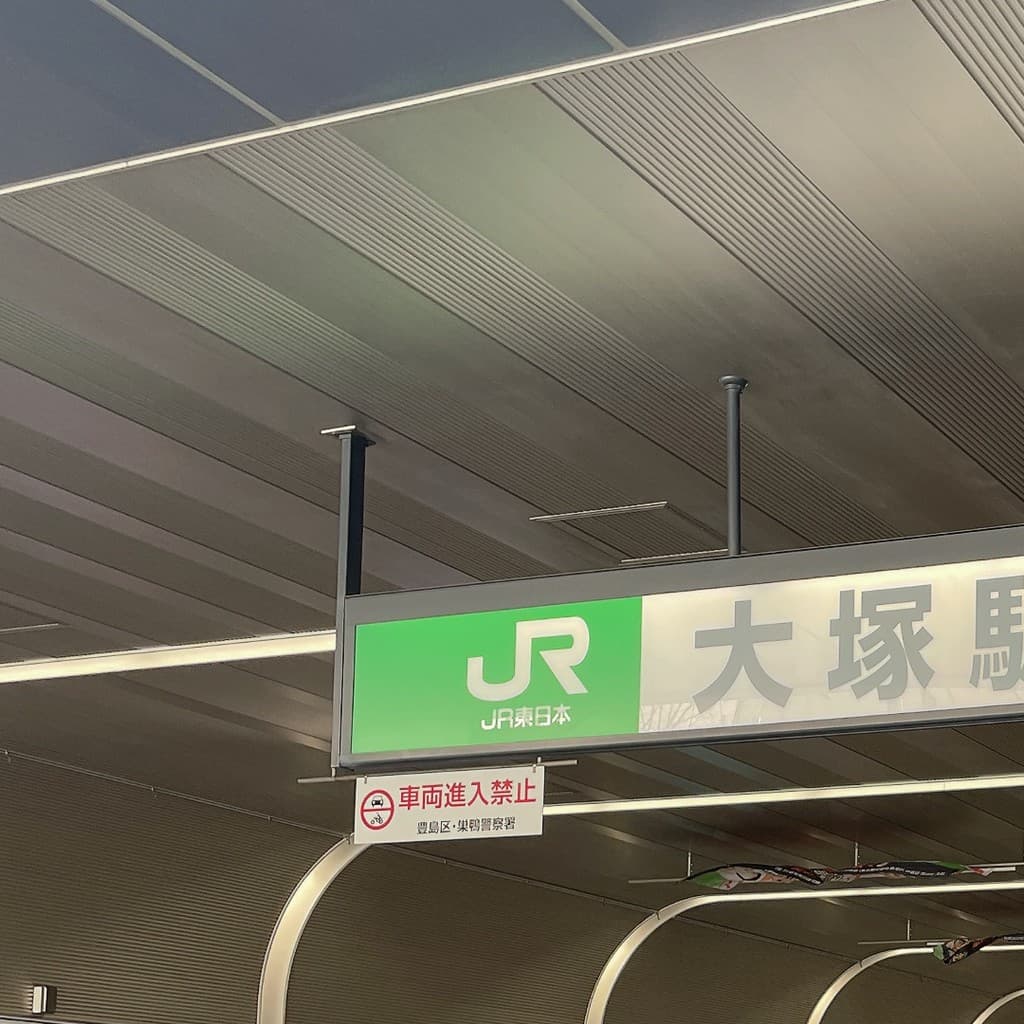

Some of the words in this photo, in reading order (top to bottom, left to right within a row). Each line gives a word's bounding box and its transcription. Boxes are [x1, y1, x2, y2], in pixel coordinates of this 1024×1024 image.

[466, 615, 591, 702] JR
[480, 703, 572, 731] JR東日本
[398, 777, 537, 811] 車両進入禁止
